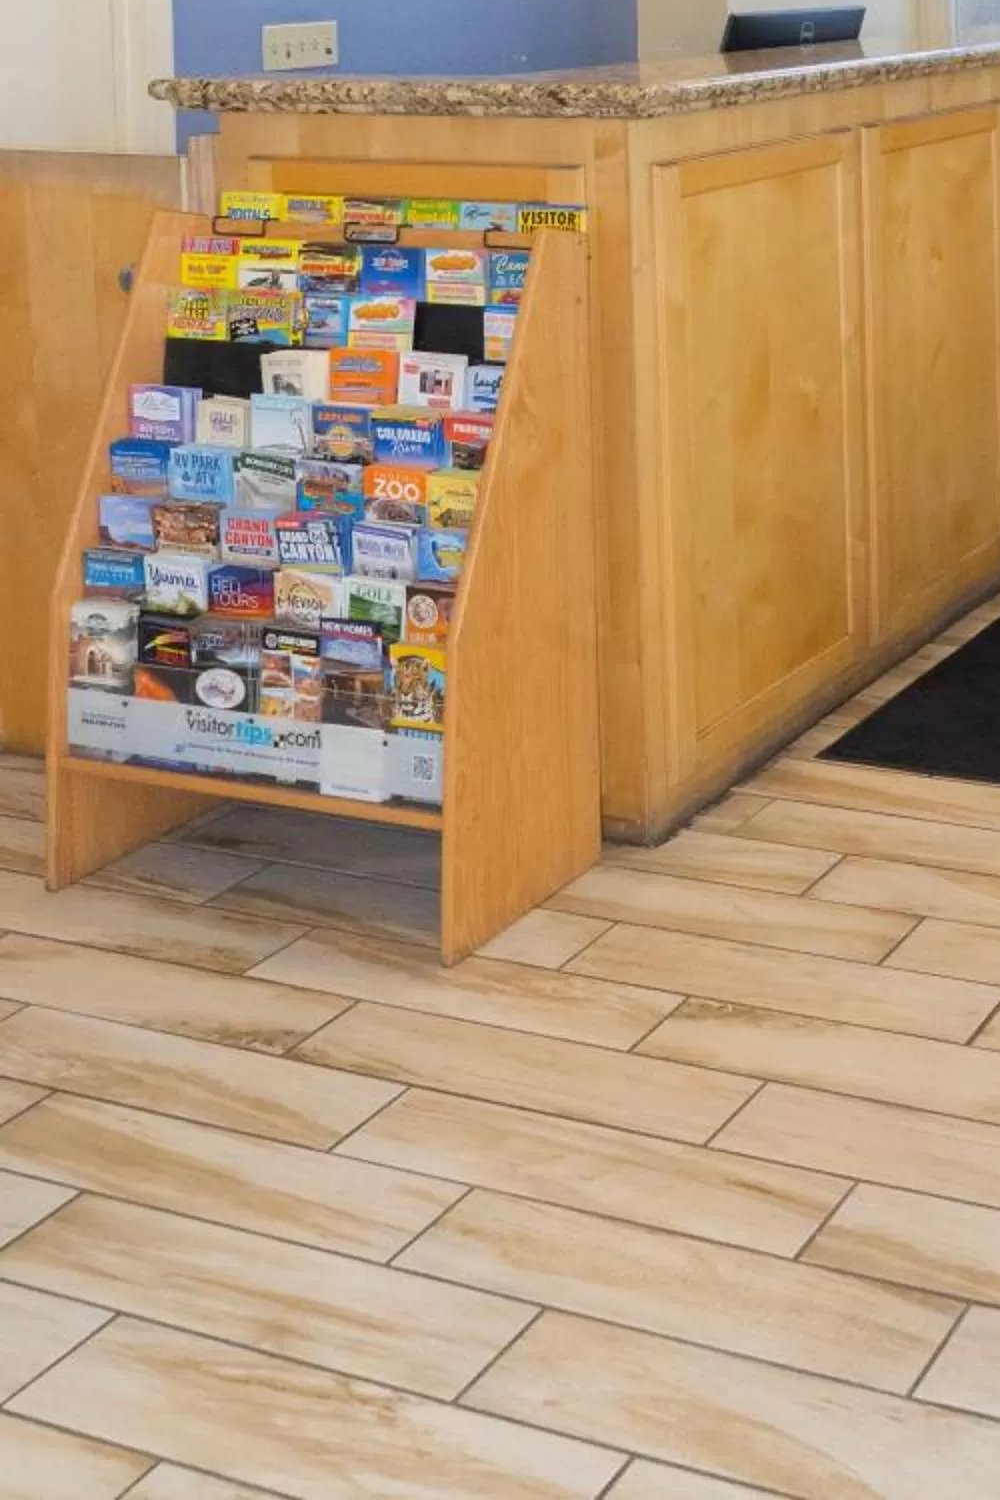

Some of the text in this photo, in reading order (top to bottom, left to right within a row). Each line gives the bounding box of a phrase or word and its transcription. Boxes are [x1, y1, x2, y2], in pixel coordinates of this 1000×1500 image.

[521, 211, 577, 226] VISITOR
[376, 427, 431, 444] COLORADO
[174, 451, 188, 468] RV
[191, 453, 220, 471] PARK
[195, 471, 216, 485] ATV
[373, 478, 420, 501] ZOO
[227, 517, 269, 533] GRAND
[225, 531, 273, 548] CANYON
[280, 542, 336, 562] CANYON
[211, 578, 241, 596] HELI
[213, 592, 259, 610] TOURS
